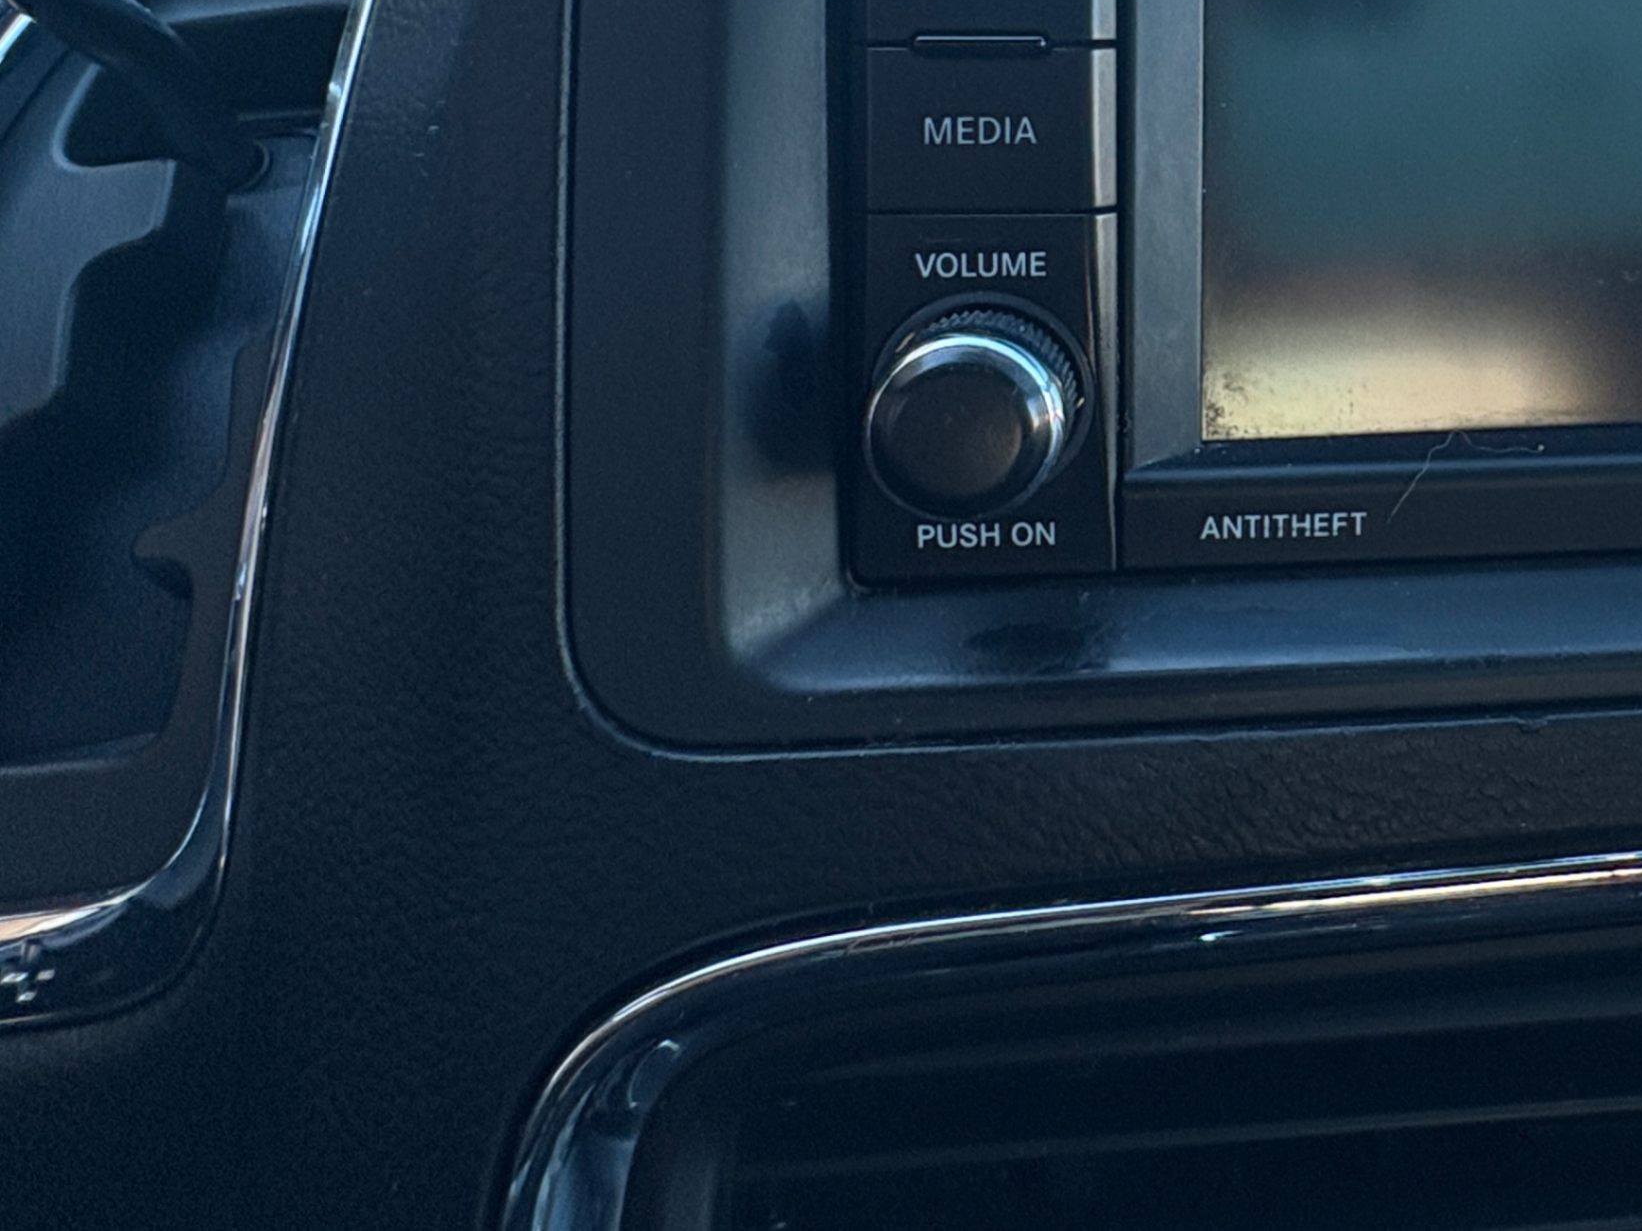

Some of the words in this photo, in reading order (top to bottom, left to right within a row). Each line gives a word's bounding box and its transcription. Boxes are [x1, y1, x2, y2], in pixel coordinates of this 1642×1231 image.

[922, 115, 1038, 146] MEDIA
[915, 251, 1047, 279] VOLUME
[916, 522, 1001, 549] PUSH
[1011, 521, 1057, 547] ON
[1200, 512, 1368, 540] ANTITHEFT
